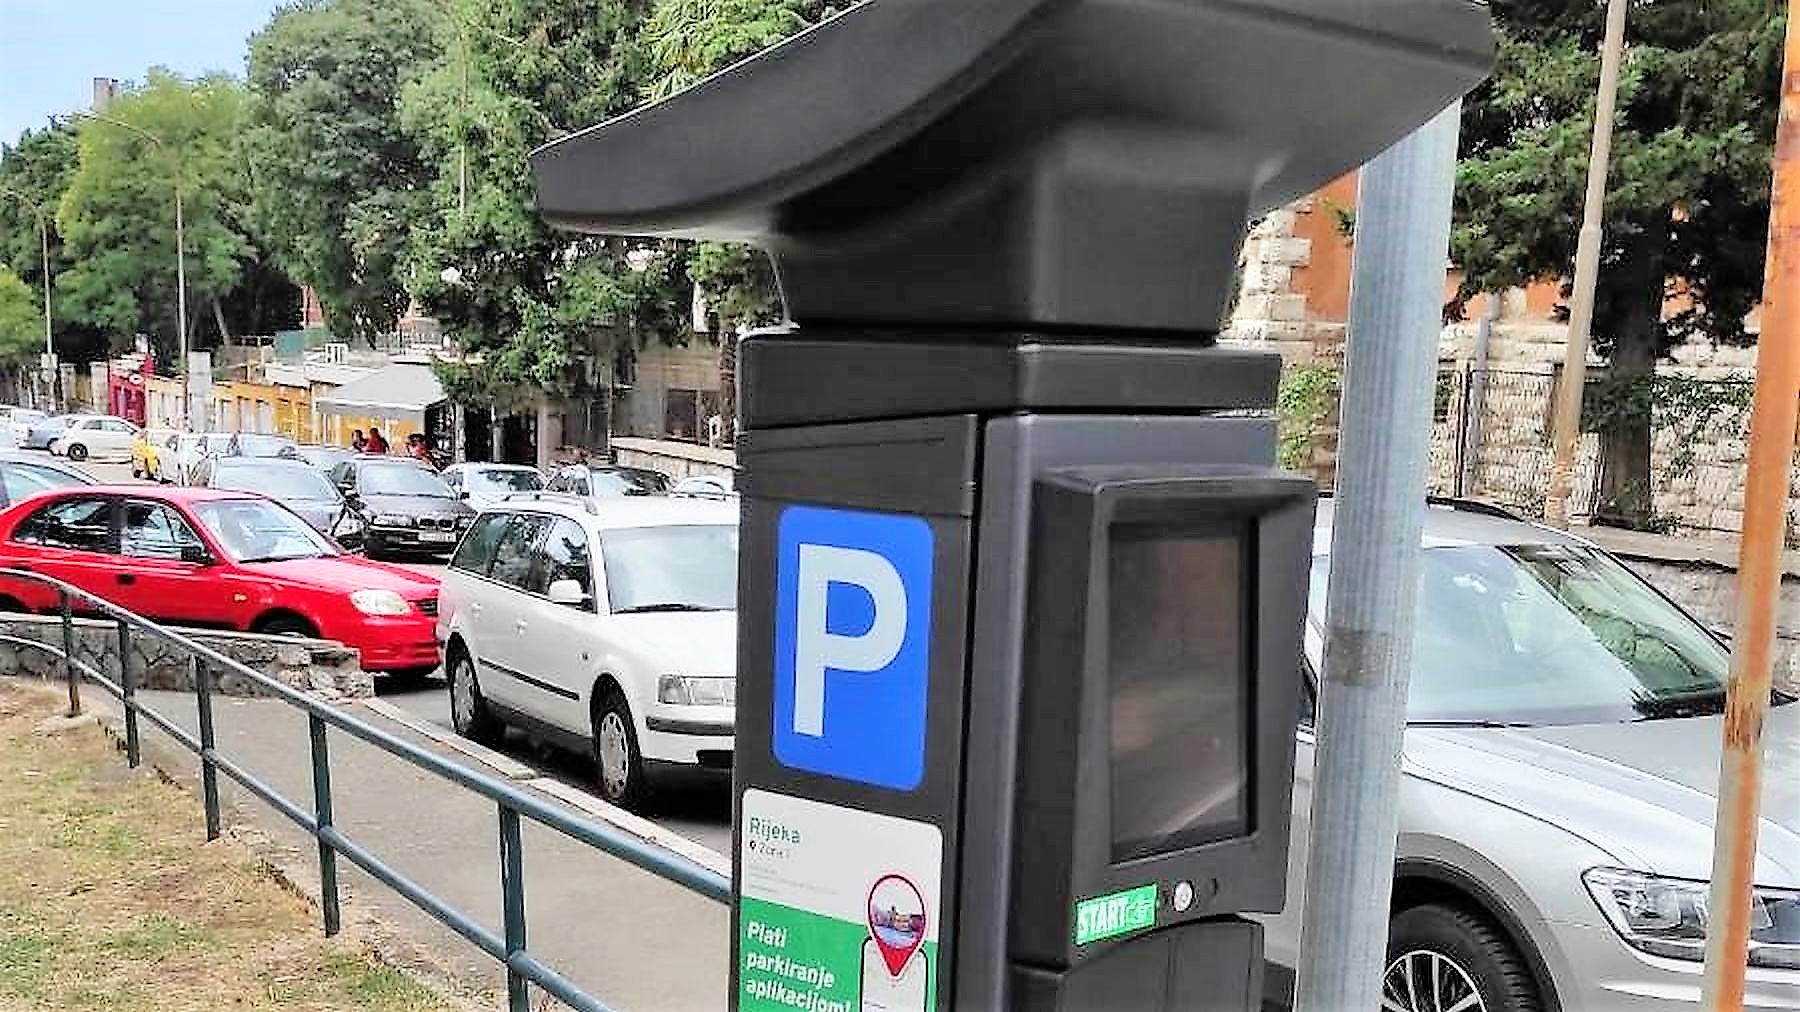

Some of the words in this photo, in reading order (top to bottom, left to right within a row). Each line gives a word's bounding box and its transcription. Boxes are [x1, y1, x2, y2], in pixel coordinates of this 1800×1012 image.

[794, 543, 908, 737] P
[749, 817, 801, 844] Rijeka
[1077, 897, 1129, 933] START
[747, 920, 788, 948] Plati
[746, 952, 836, 990] parkiranje
